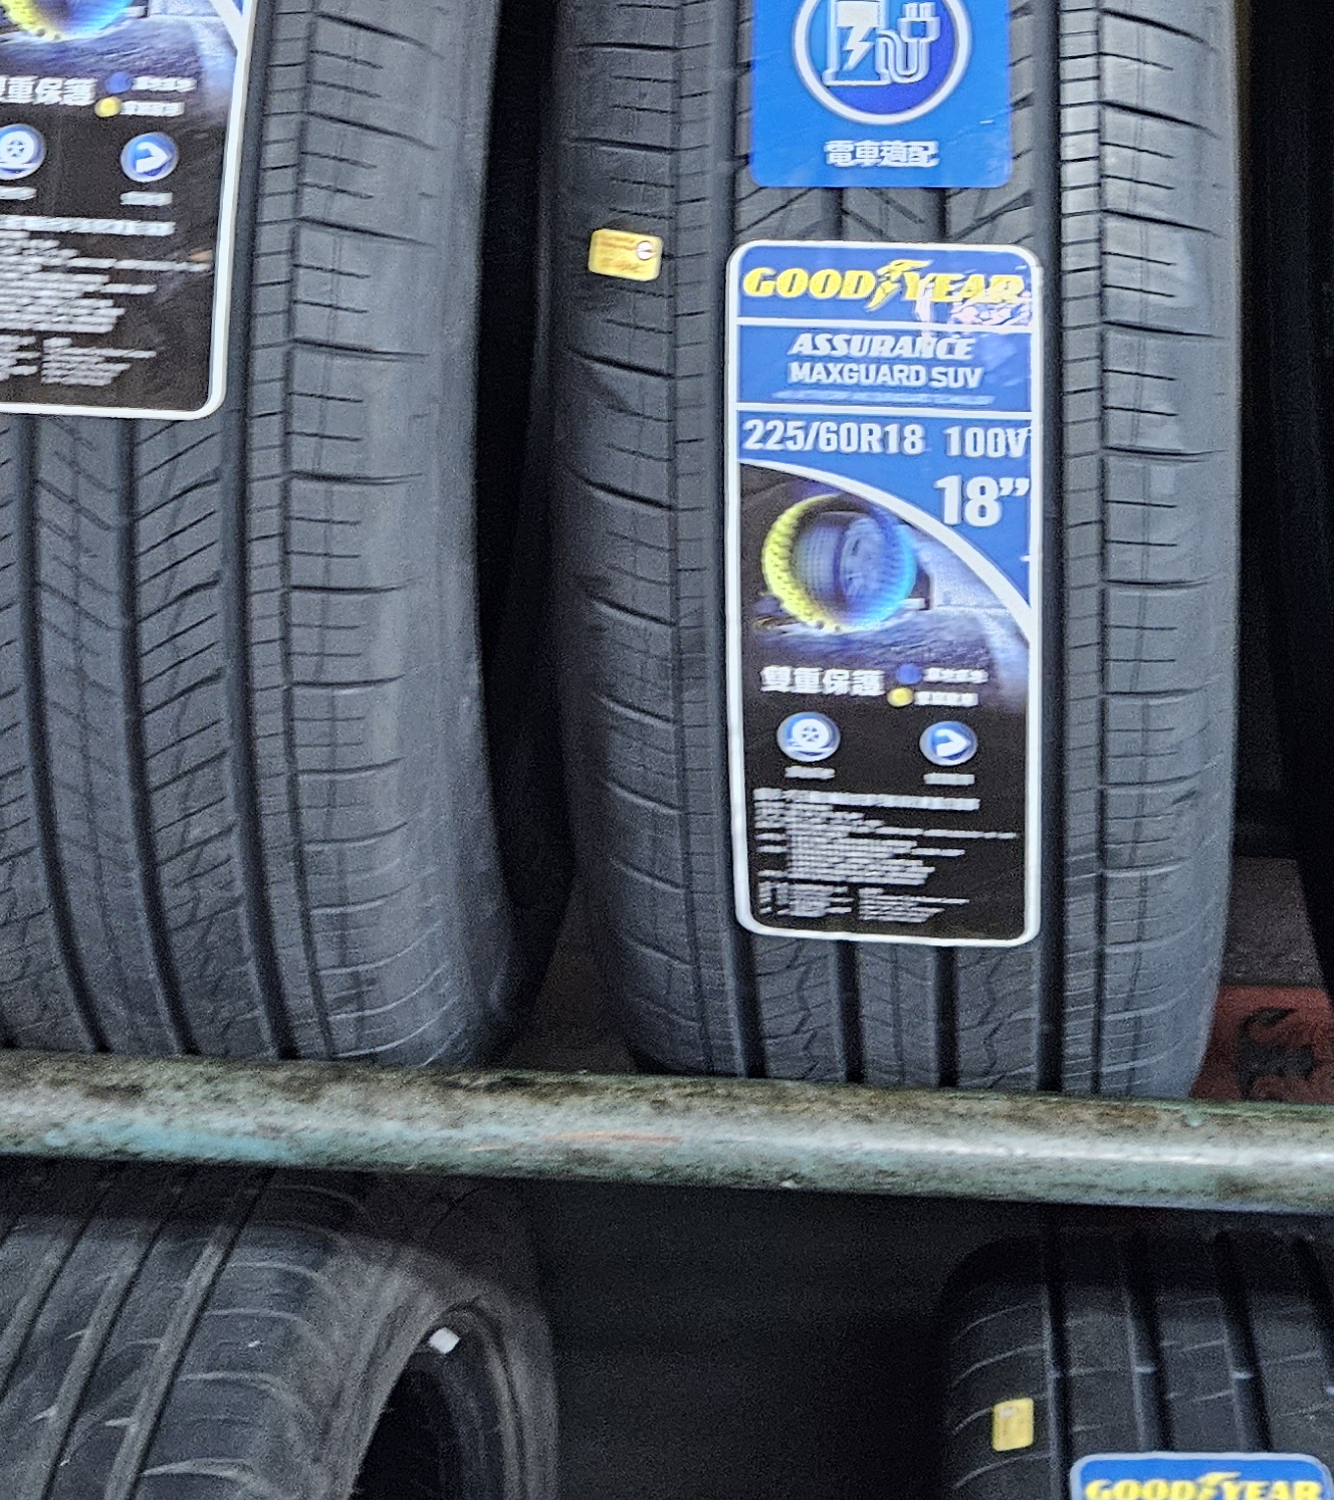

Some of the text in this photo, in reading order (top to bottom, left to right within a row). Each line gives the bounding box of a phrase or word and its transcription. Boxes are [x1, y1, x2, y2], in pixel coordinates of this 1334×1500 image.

[743, 259, 1025, 310] GOODYEAR
[787, 333, 976, 360] ASSURANCE
[788, 362, 985, 389] MAXGUARD SUV
[743, 419, 1028, 458] 225/60R18 100V
[1085, 1472, 1322, 1500] GOODYEAR
